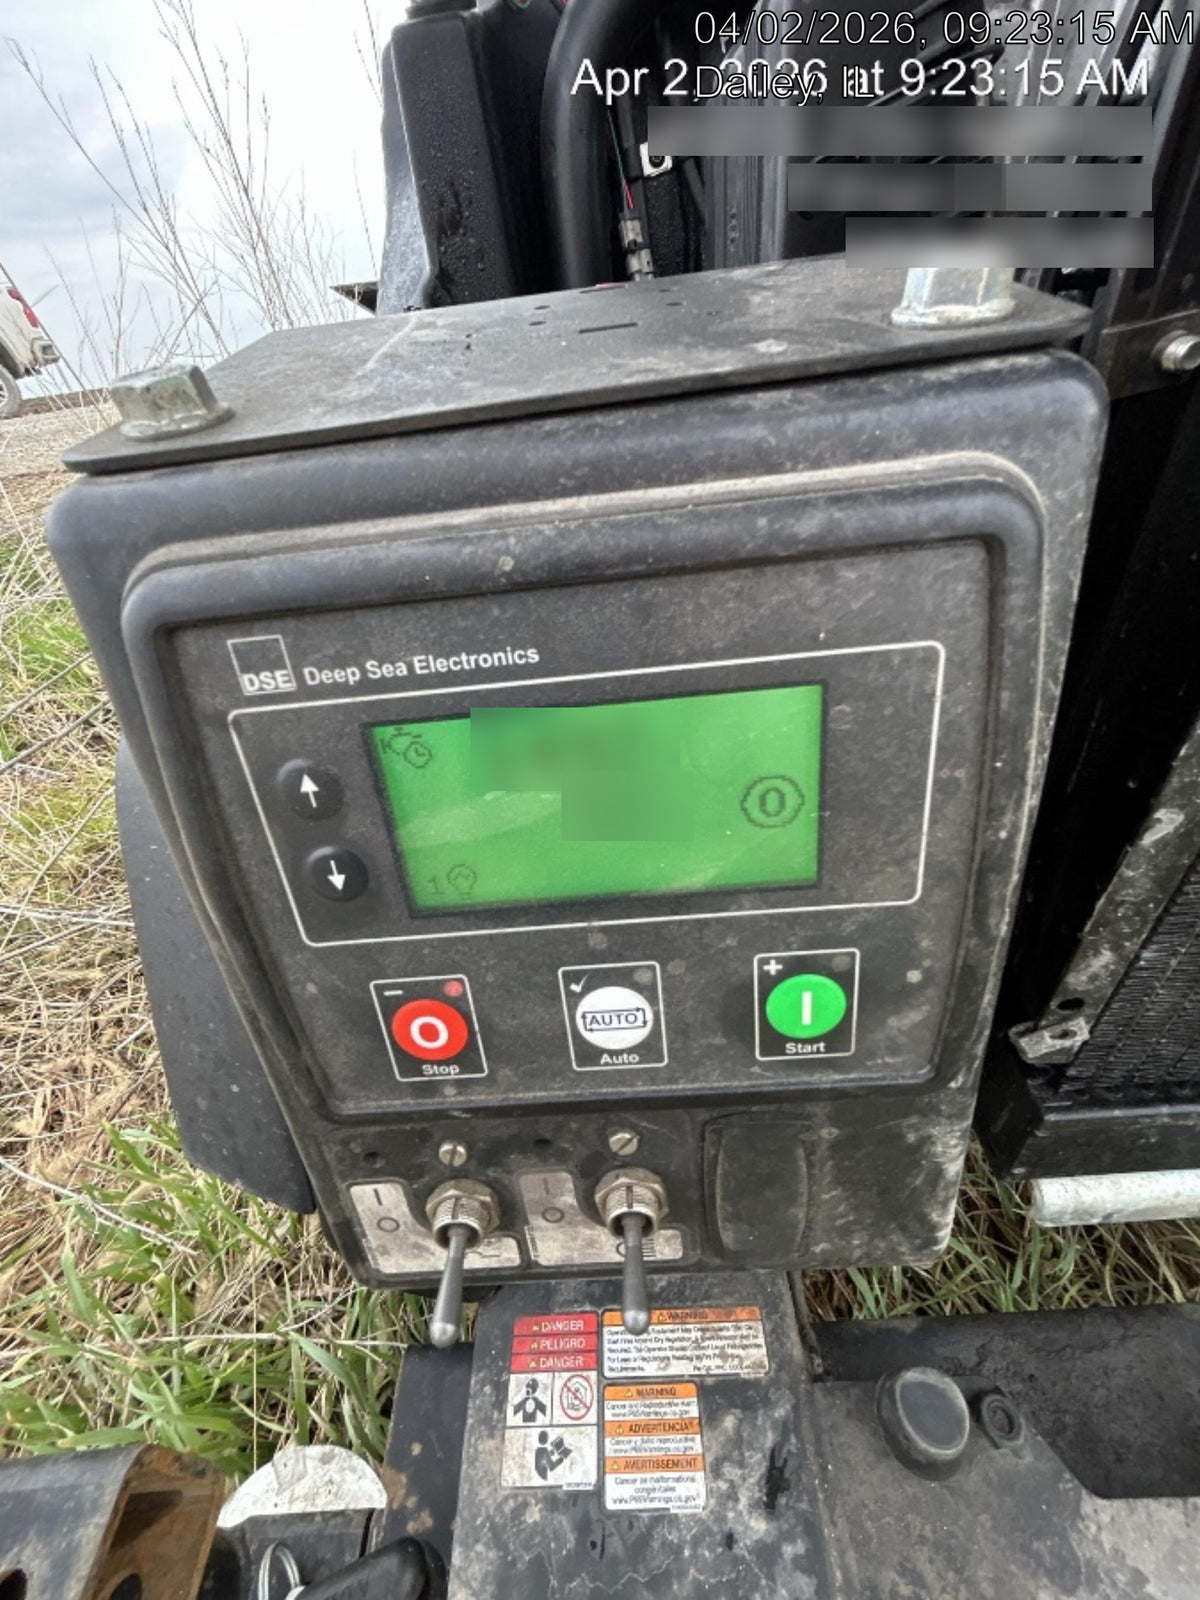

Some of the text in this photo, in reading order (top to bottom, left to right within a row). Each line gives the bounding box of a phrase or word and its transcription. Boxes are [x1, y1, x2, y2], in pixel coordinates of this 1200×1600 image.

[303, 646, 540, 686] Deep Sea Electronics
[242, 669, 293, 692] DSE
[588, 1012, 639, 1027] AUTO
[785, 1041, 827, 1055] Start
[600, 1052, 641, 1065] Auto
[421, 1064, 460, 1076] Stop
[667, 1311, 708, 1321] WARNING
[541, 1319, 585, 1333] DANGER
[540, 1337, 586, 1351] PELIGRO
[539, 1355, 585, 1369] DANGER
[636, 1386, 677, 1397] WARNING
[629, 1421, 689, 1434] ADVERTENCIA
[623, 1458, 698, 1471] AVERTISSEMENT
